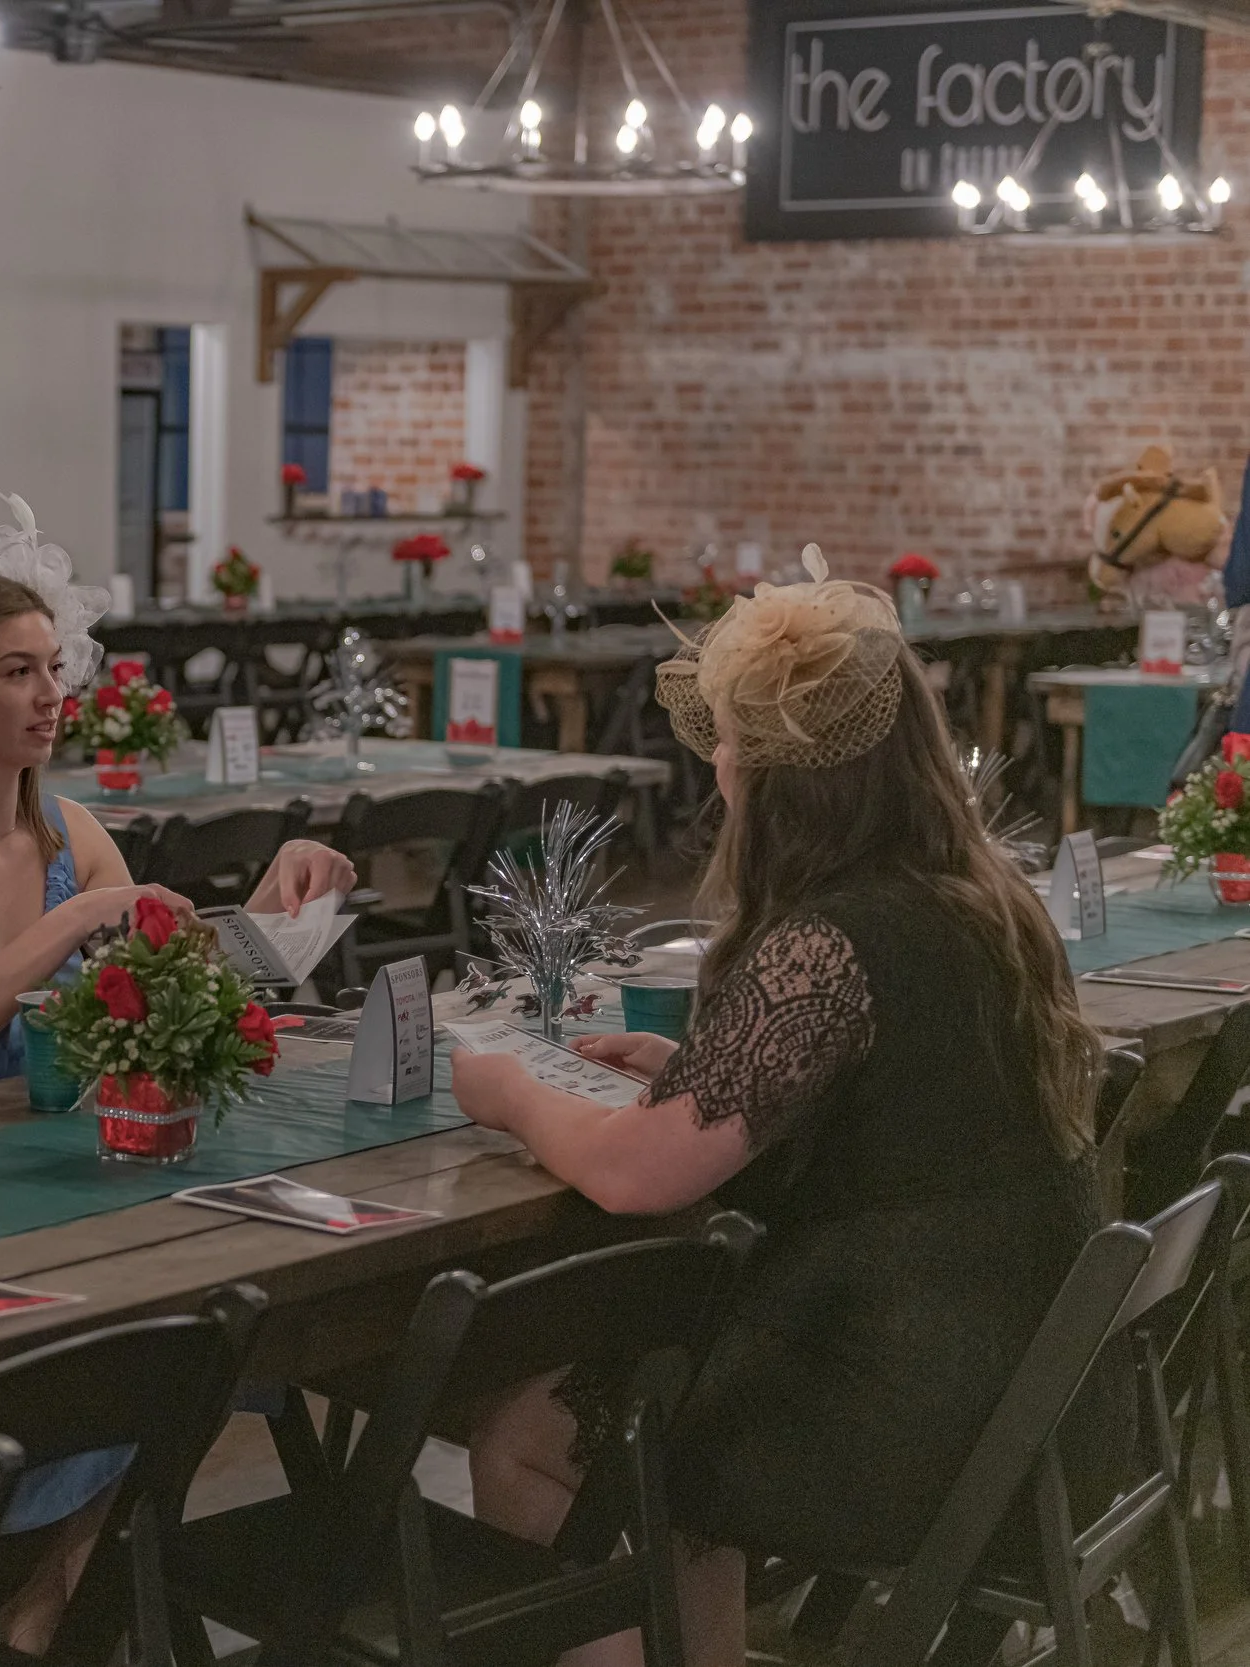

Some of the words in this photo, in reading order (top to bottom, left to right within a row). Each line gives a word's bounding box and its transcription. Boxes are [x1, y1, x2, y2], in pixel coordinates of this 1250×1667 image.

[789, 38, 891, 133] the
[916, 38, 1166, 142] factory
[222, 917, 275, 978] SPONSORS
[390, 967, 424, 985] SPONSORS
